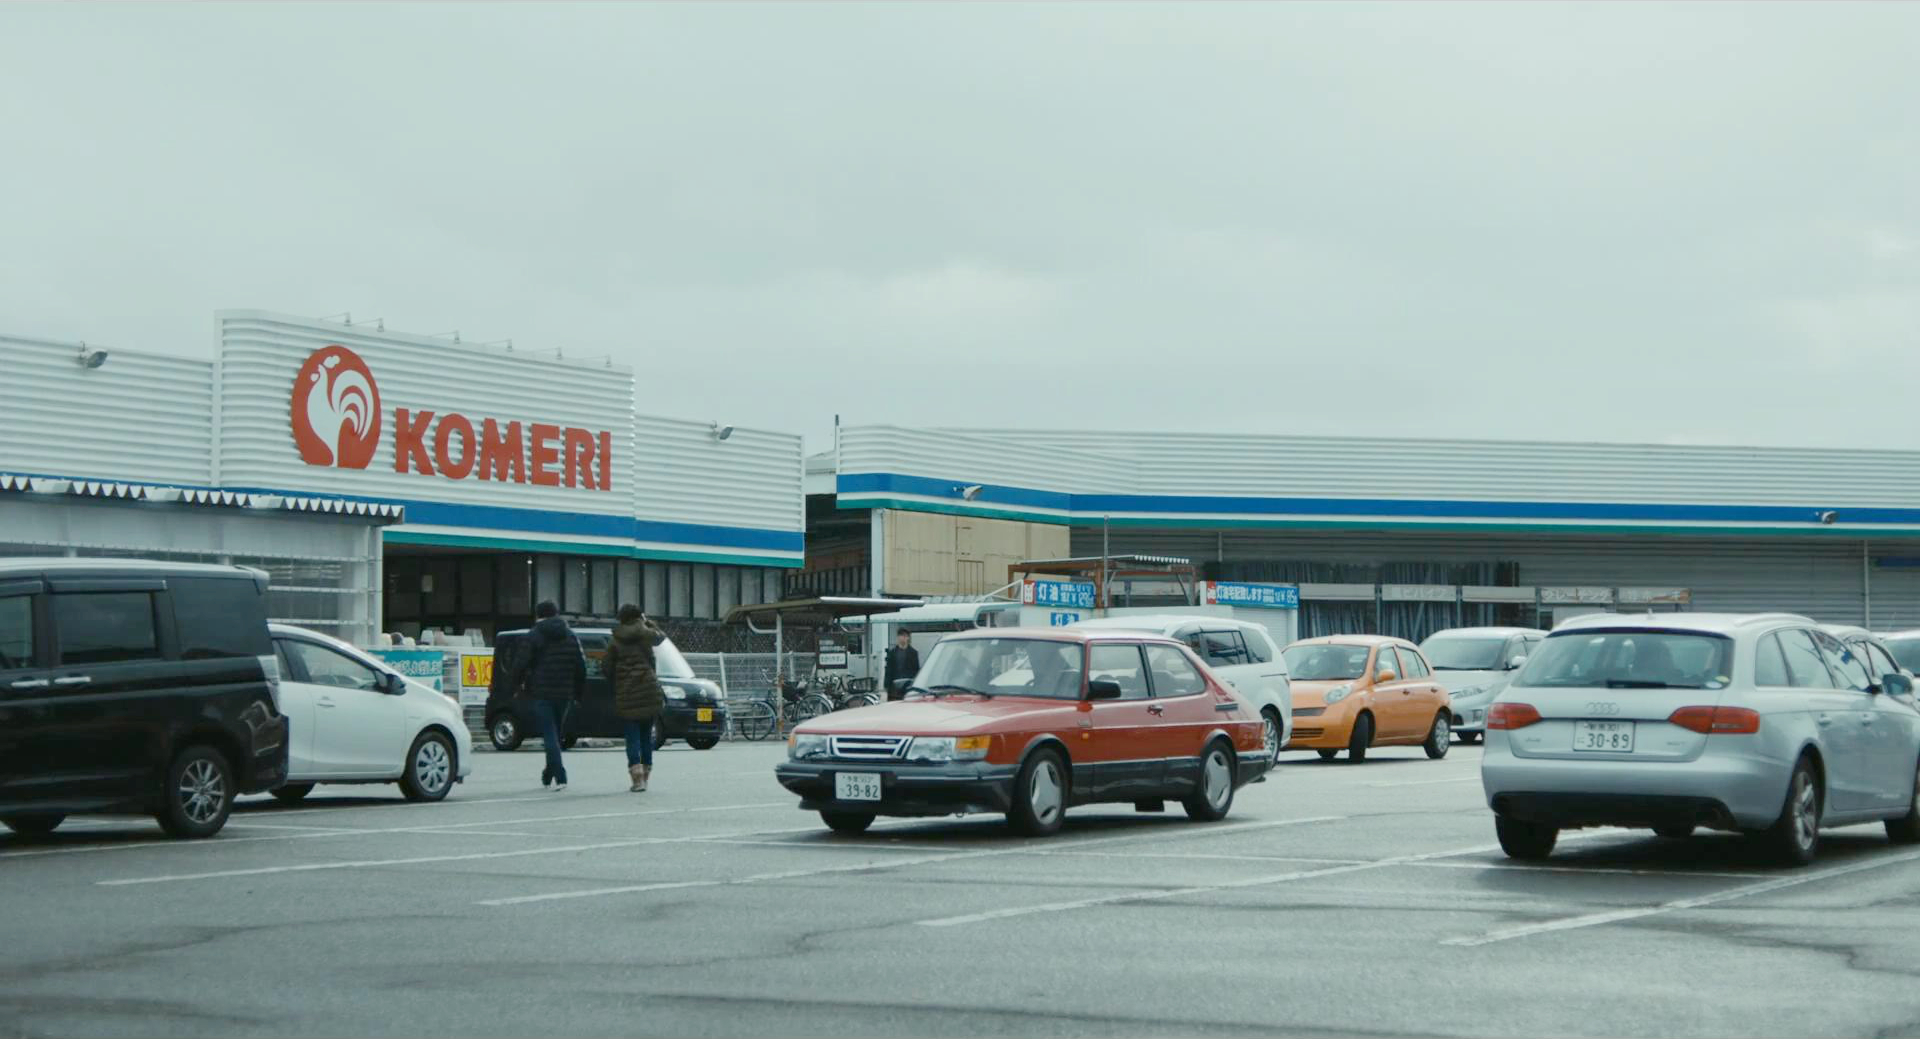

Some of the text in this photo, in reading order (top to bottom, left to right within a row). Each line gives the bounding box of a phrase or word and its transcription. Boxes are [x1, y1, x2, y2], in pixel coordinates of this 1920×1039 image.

[395, 407, 611, 491] KOMERI
[1586, 732, 1630, 749] 30-89
[846, 783, 879, 798] 39-82
